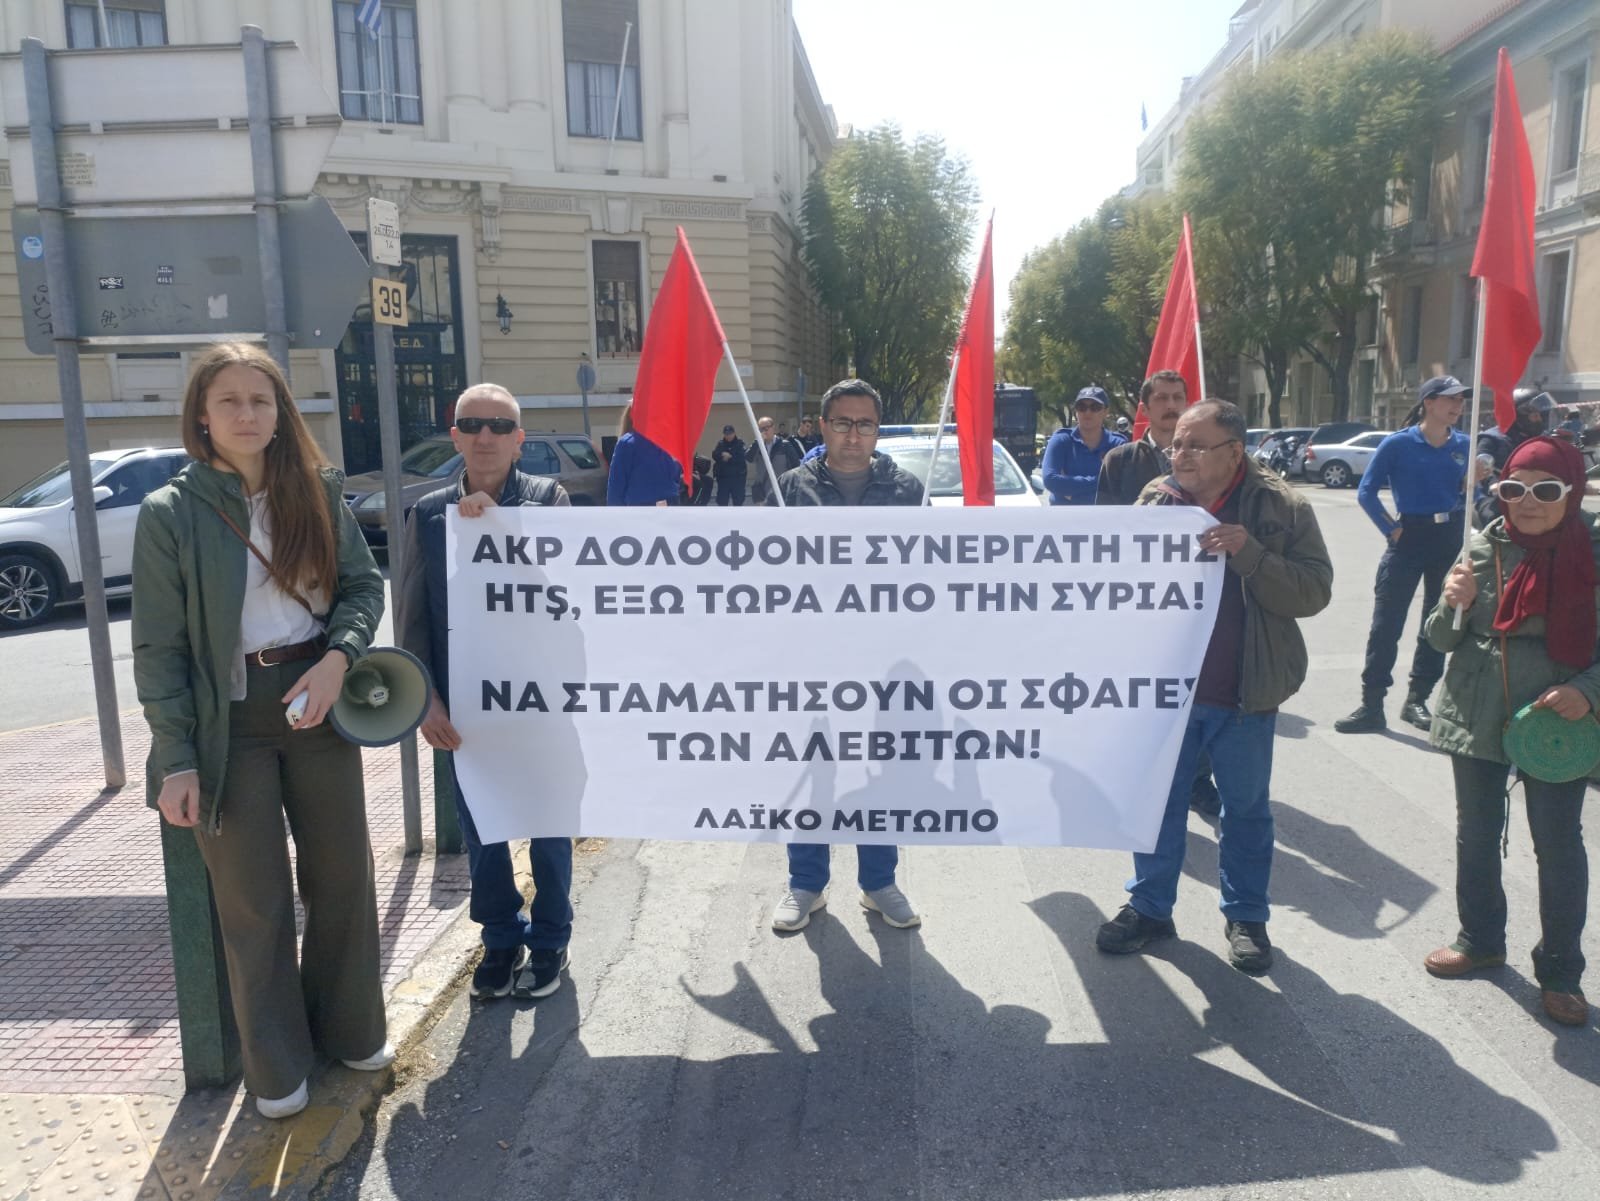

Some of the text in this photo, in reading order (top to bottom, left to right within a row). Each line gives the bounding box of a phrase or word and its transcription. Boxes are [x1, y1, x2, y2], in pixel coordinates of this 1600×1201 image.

[379, 286, 402, 318] 39
[574, 529, 853, 572] ΔΟΛΟΦΟΝΕ
[865, 534, 1121, 565] ΣΥΝΕΡΓΑΤΗ
[594, 584, 685, 615] ΕΞΩ
[696, 583, 824, 614] ΤΩΡΑ
[834, 582, 936, 613] ΑΠΟ
[947, 582, 1038, 612] ΤΗΝ
[1050, 581, 1204, 611] ΣΥΡΙΑ!
[481, 679, 550, 713] ΝΑ
[561, 679, 934, 713] ΣΤΑΜΑΤΗΣΟΥΝ
[948, 678, 1008, 711] ΟΙ
[647, 729, 1041, 762] ΤΩΝ ΑΛΕΒΙΤΩΝ!
[693, 804, 999, 833] ΛΑΪΚΟ ΜΕΤΩΠΟ
